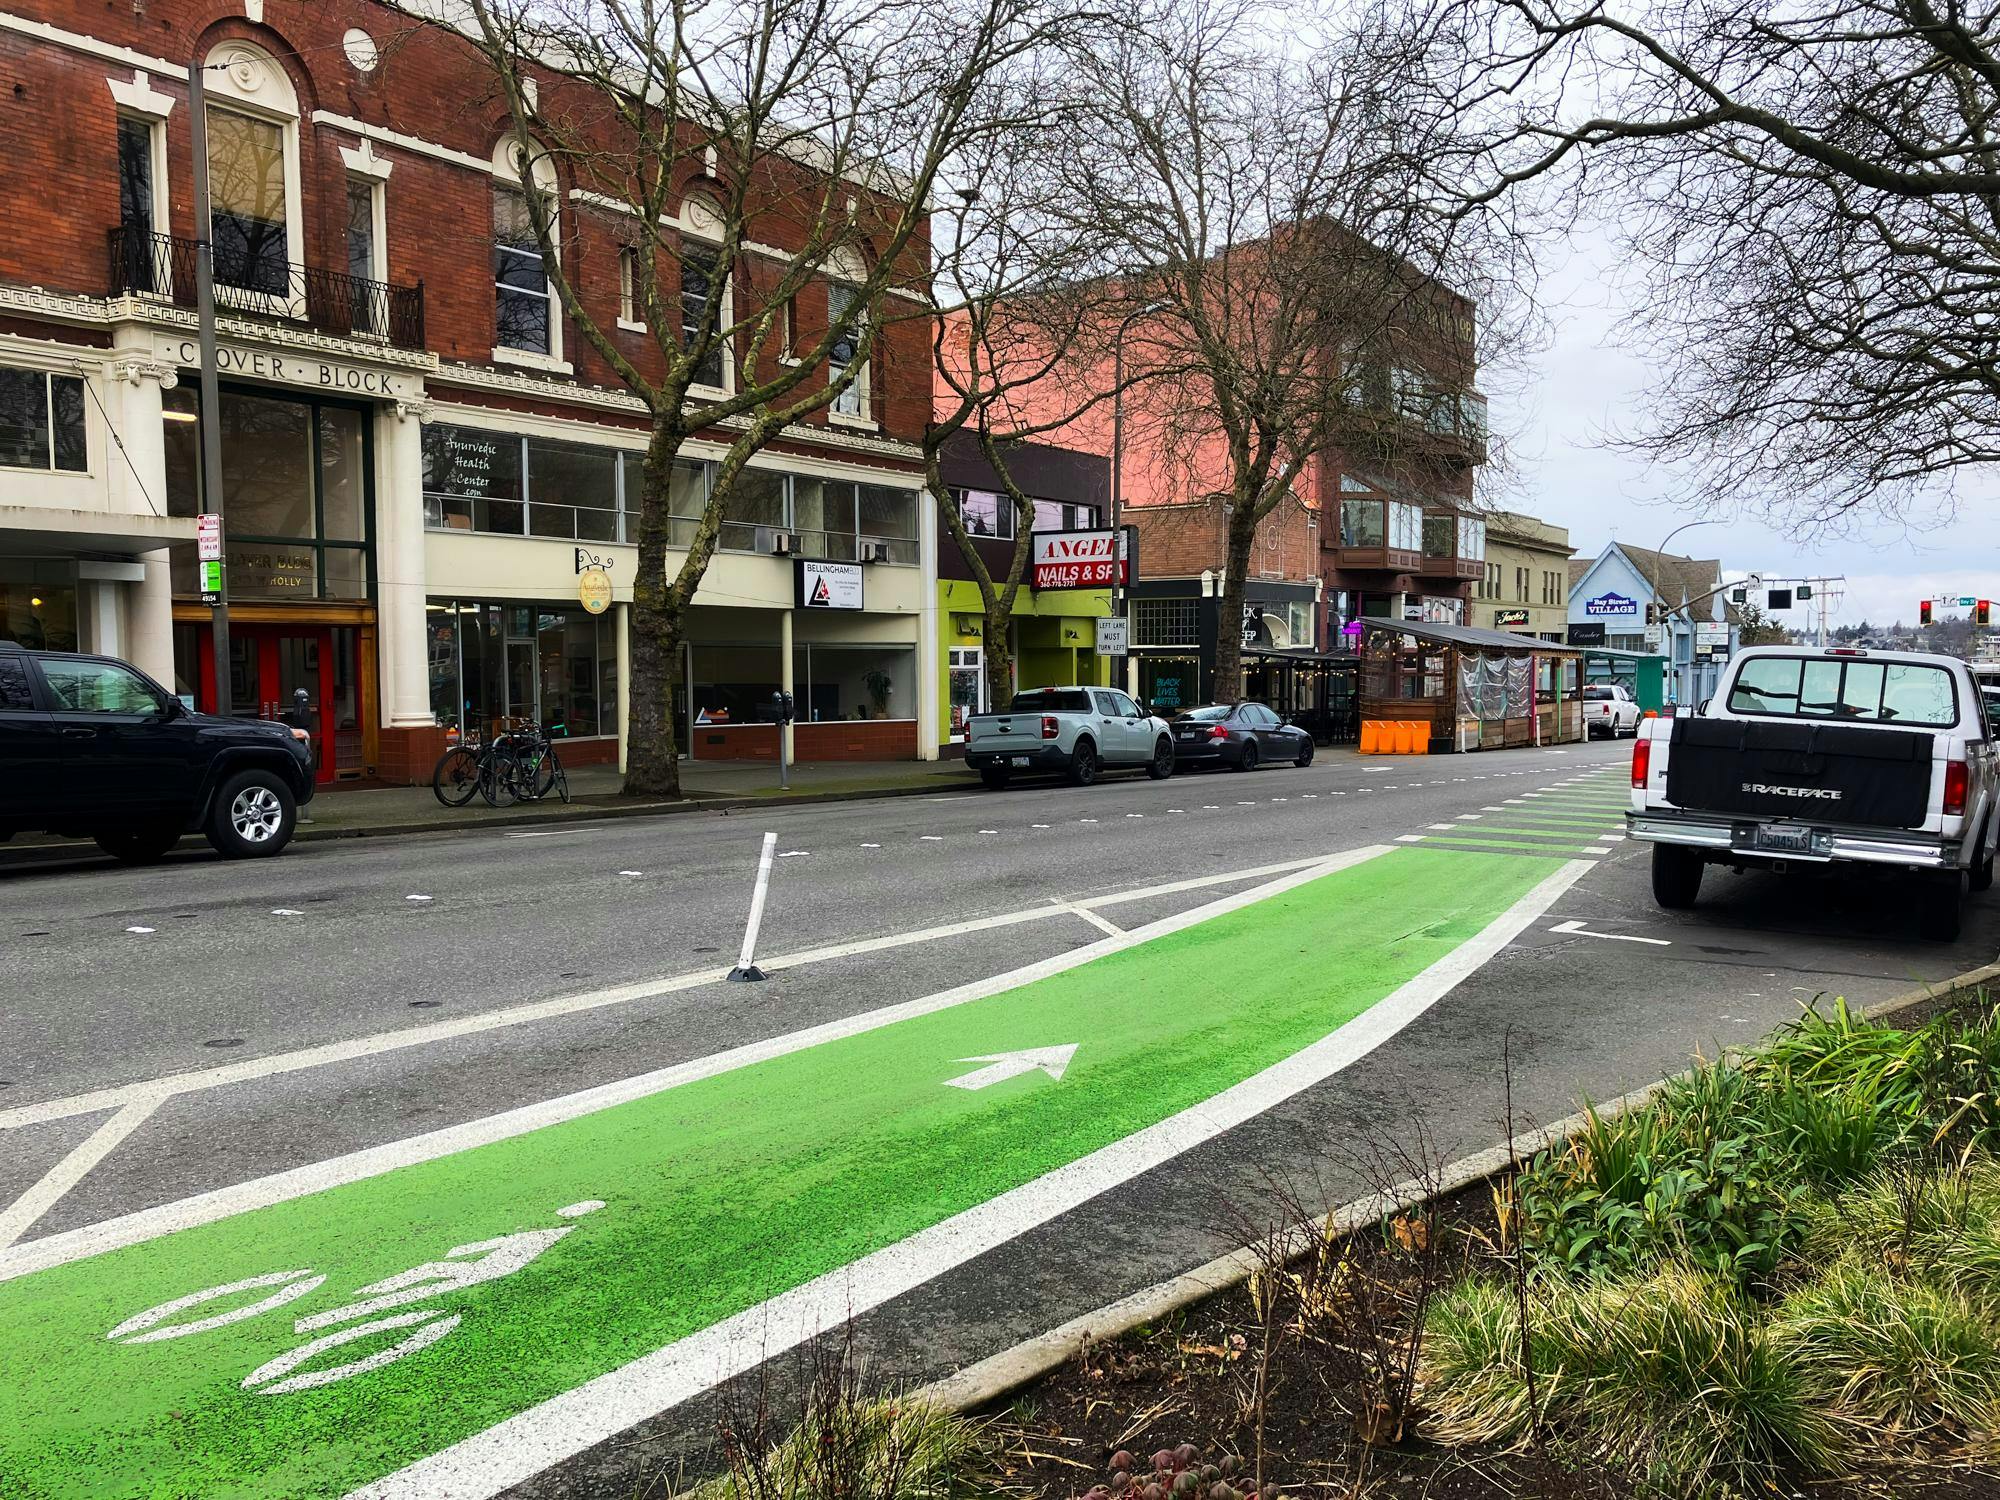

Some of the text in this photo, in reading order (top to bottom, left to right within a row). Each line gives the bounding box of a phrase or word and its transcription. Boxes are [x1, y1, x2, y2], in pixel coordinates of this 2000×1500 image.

[180, 342, 393, 394] COVER BLOCK
[445, 437, 497, 458] Ayurvedic
[454, 456, 490, 470] Health
[456, 473, 490, 486] Center
[1038, 565, 1080, 582] NAILS
[1082, 565, 1092, 580] &
[270, 576, 301, 586] HOLLY
[1588, 605, 1635, 614] VILLAGE
[1104, 632, 1120, 641] MUST
[1156, 678, 1181, 687] BLACK
[1156, 687, 1178, 696] LIVES
[1752, 783, 1842, 799] RACEFACE
